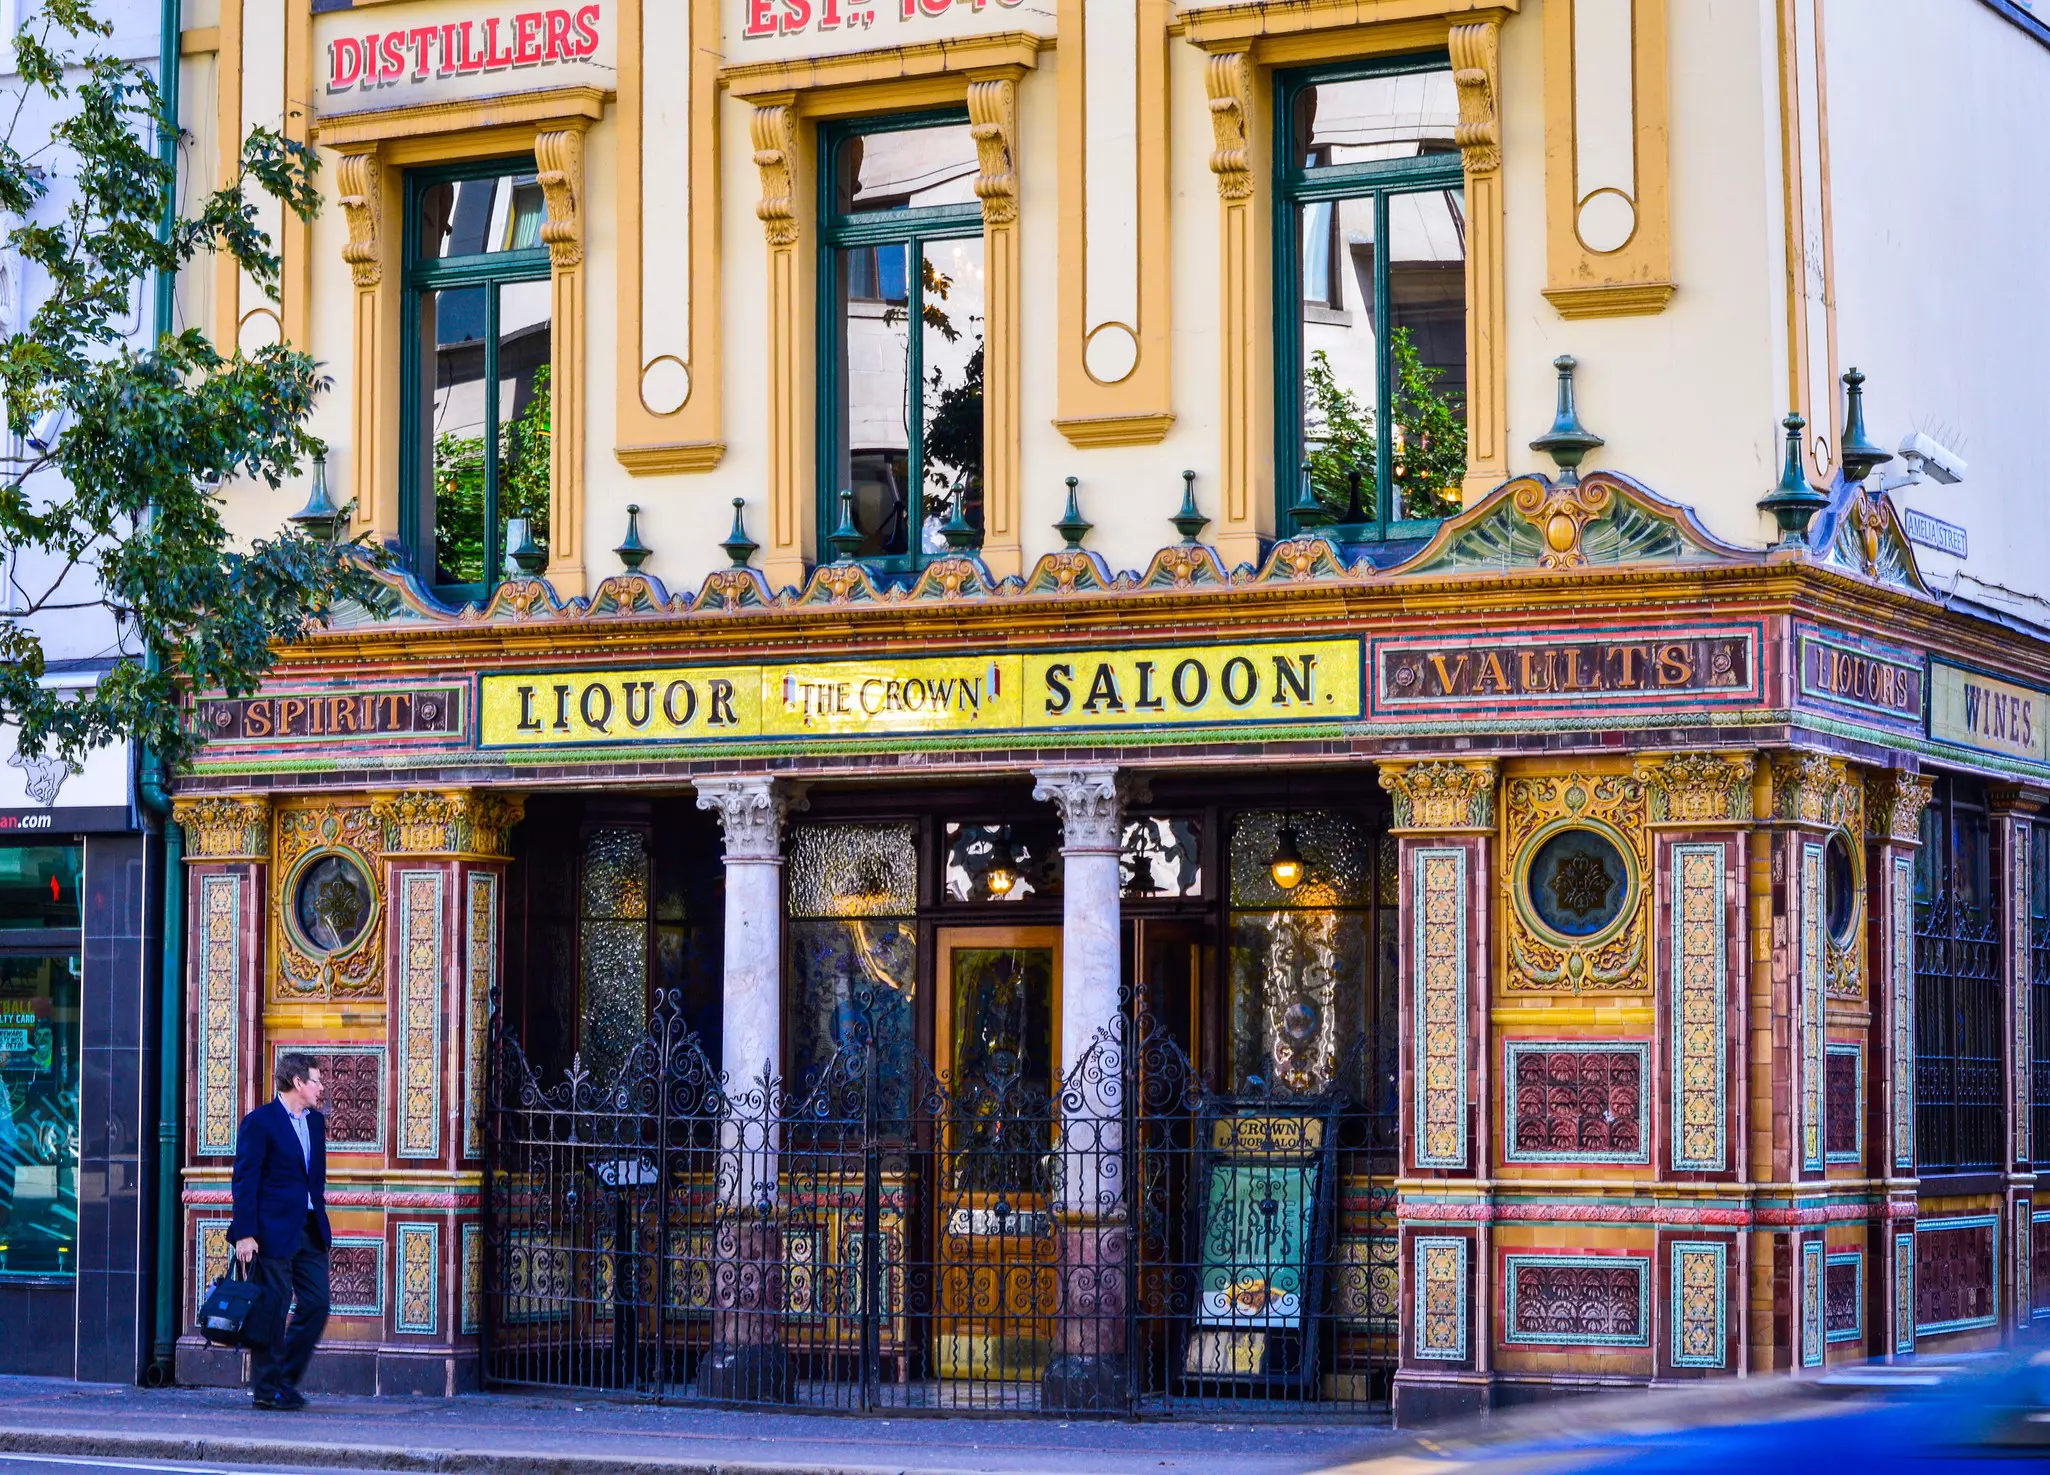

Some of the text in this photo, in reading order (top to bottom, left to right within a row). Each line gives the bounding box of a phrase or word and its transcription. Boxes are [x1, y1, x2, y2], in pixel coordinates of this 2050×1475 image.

[328, 4, 600, 92] DISTILLERS
[1908, 514, 1965, 553] AMELIA STREET
[1429, 644, 1695, 695] VAULTS
[1816, 648, 1908, 708] LIQUORS
[245, 694, 412, 737] SPIRIT
[516, 653, 1335, 735] LIQUOR THE CROWN SALOON.
[1963, 683, 2036, 750] WINES.
[0, 815, 52, 829] an.com
[16, 1014, 35, 1023] CARD
[1220, 1137, 1314, 1148] LIUOR ALON
[1238, 1123, 1298, 1136] CROWN
